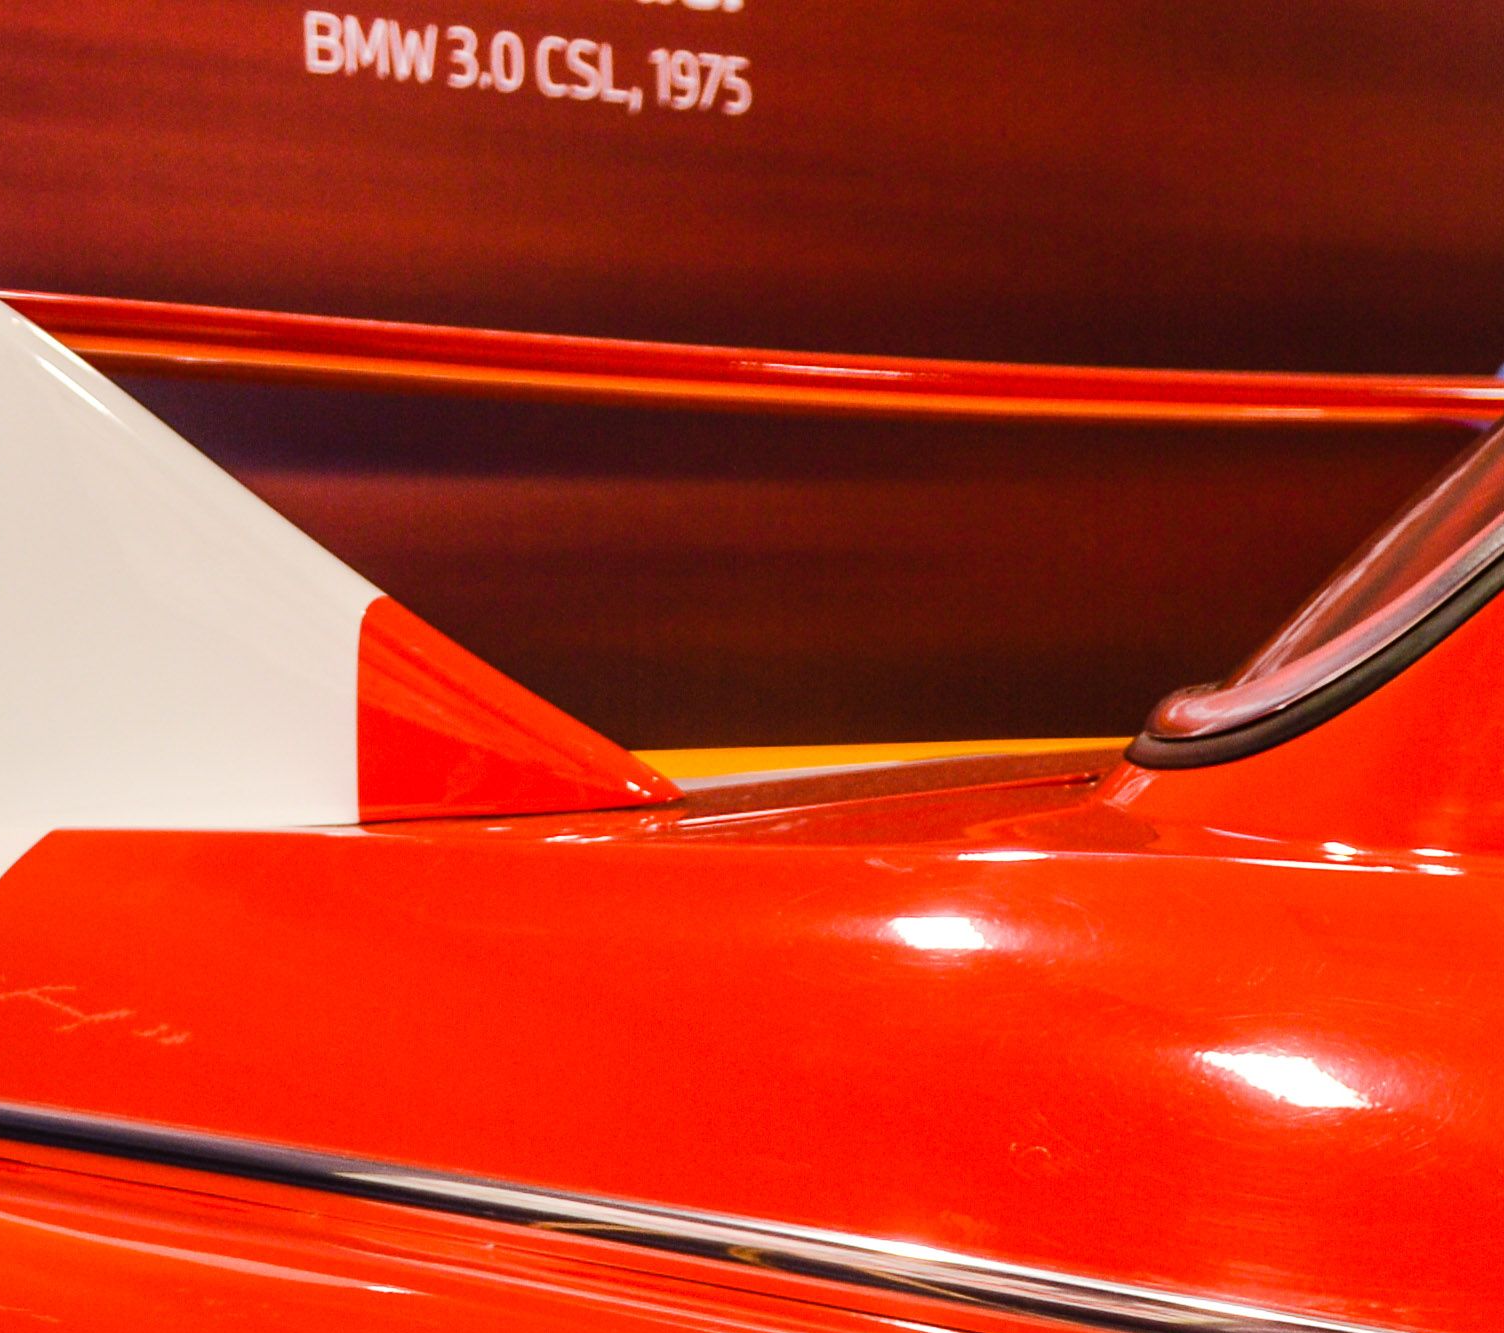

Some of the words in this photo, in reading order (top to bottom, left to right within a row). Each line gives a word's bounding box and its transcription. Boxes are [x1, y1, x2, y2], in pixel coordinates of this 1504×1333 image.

[304, 10, 439, 84] BMW
[446, 26, 525, 93] 3.0
[535, 35, 644, 114] CSL,
[649, 48, 754, 116] 1975
